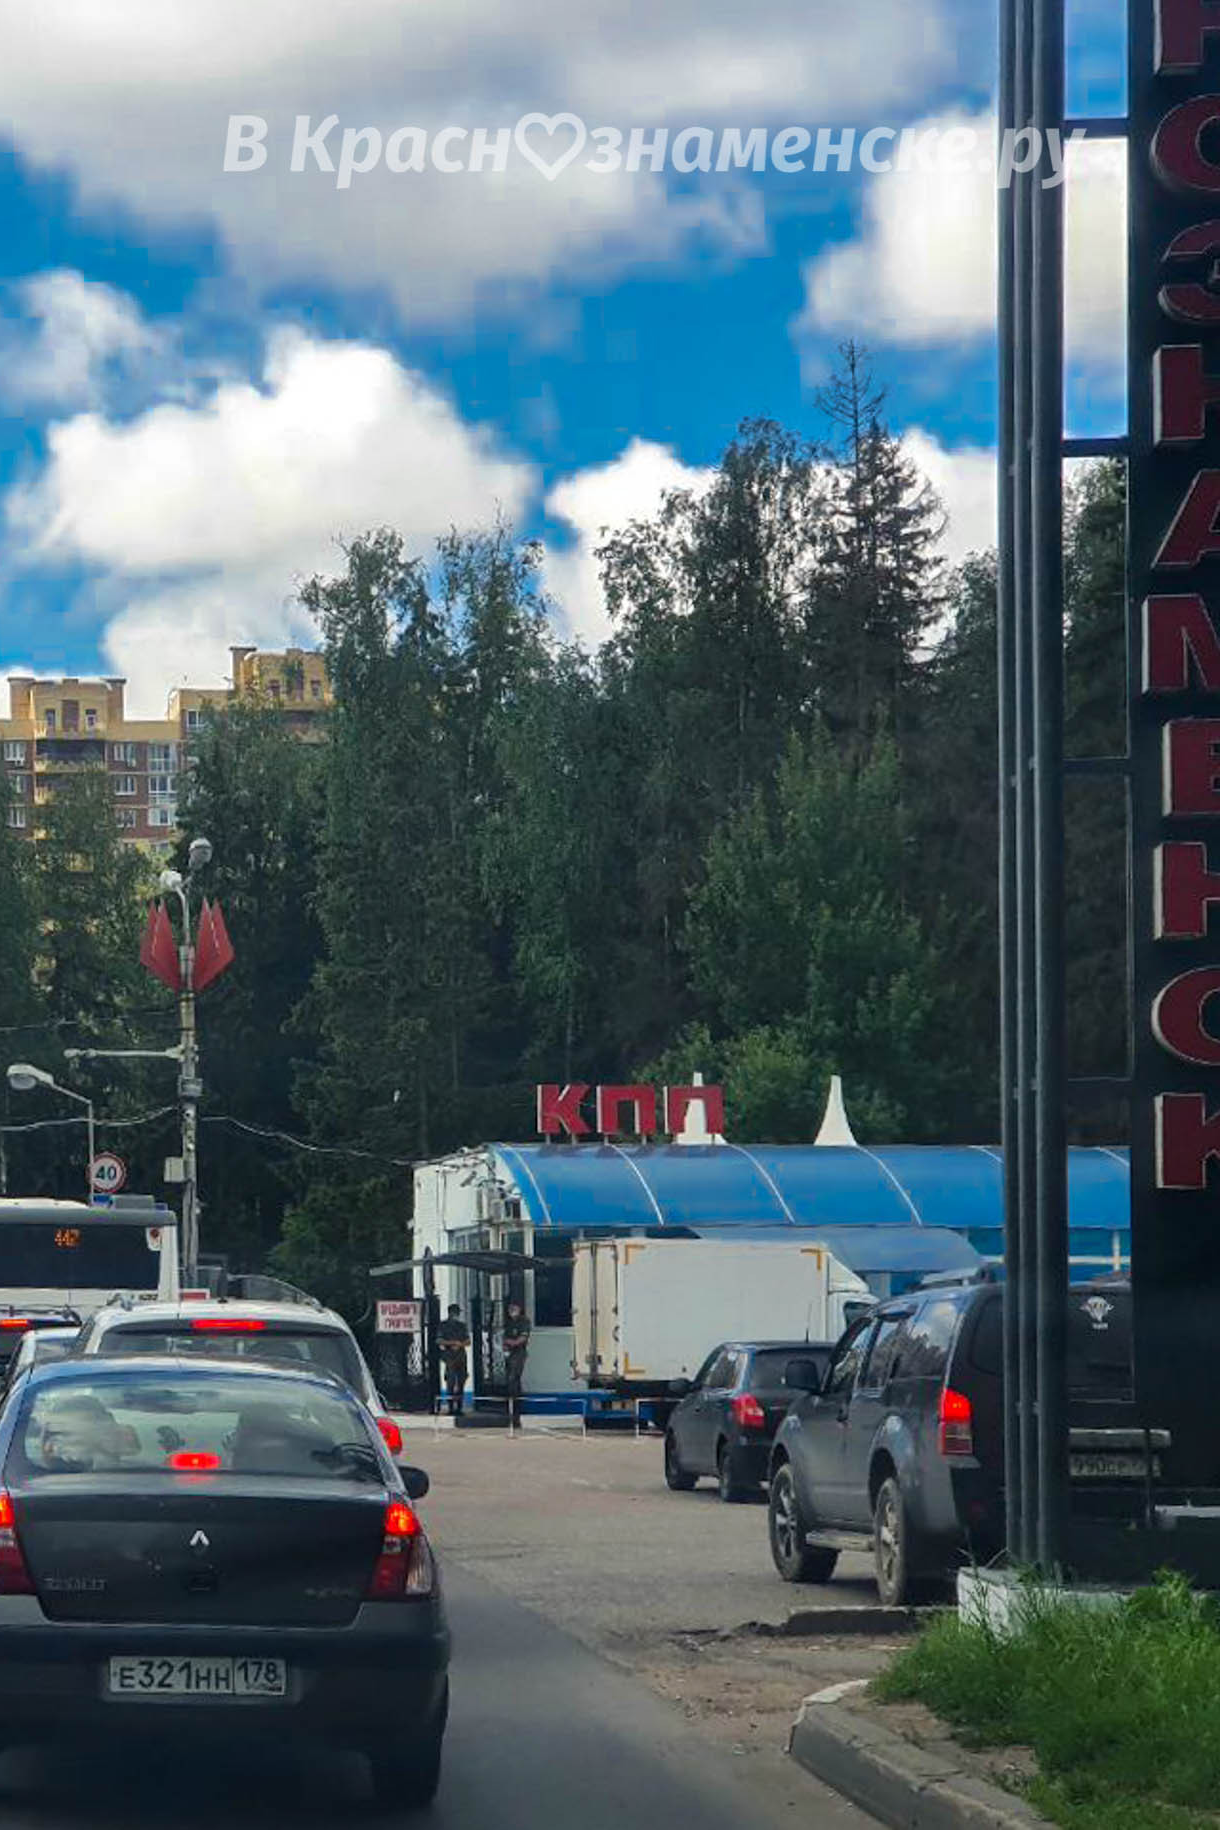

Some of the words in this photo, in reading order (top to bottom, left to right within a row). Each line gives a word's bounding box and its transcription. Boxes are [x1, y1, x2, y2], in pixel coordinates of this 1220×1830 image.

[537, 1084, 724, 1135] КПП
[95, 1165, 117, 1181] 40
[118, 1660, 231, 1690] Е321НН
[237, 1660, 279, 1684] 178
